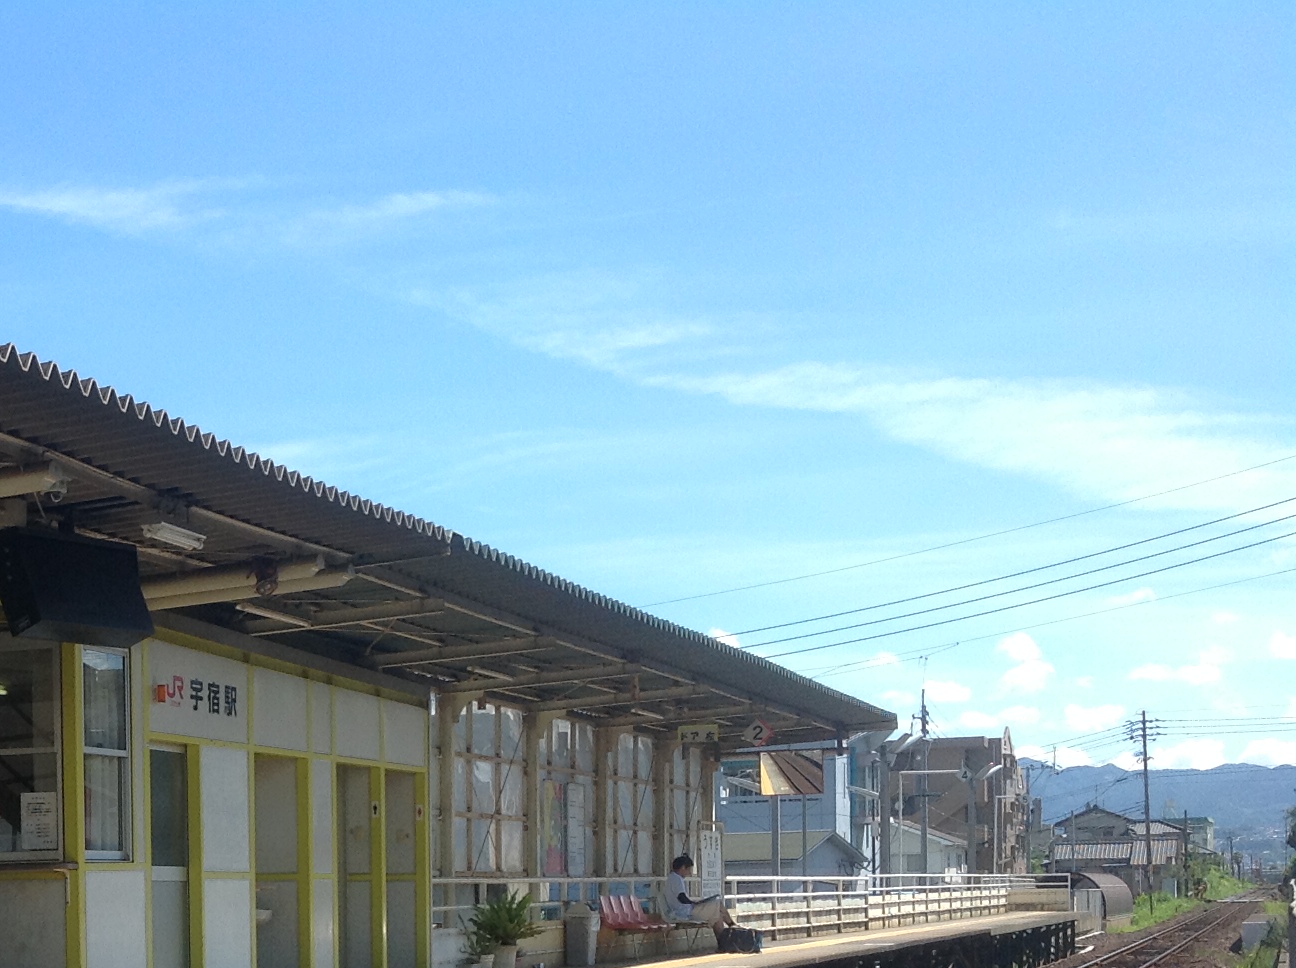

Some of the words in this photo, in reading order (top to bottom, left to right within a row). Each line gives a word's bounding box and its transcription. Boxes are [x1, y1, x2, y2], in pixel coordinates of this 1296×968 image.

[166, 675, 184, 699] JR
[190, 679, 237, 717] 宇宿駅
[752, 725, 764, 741] 2
